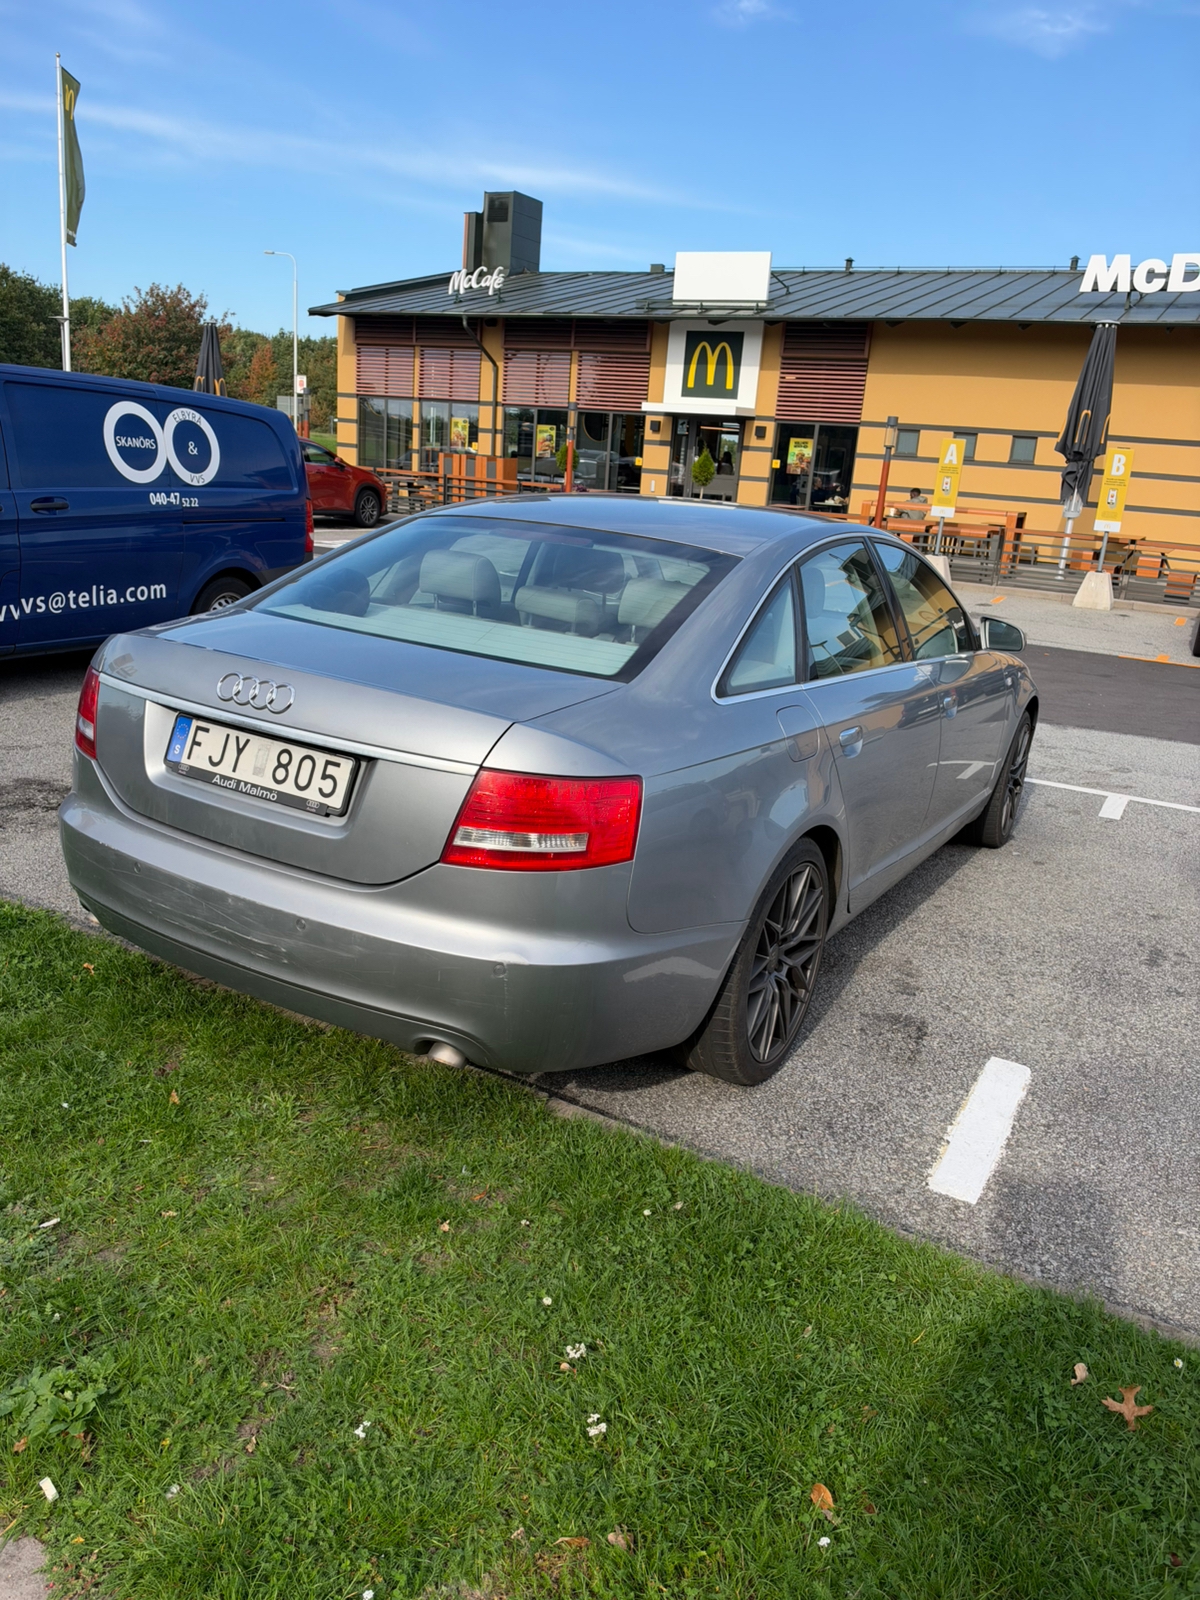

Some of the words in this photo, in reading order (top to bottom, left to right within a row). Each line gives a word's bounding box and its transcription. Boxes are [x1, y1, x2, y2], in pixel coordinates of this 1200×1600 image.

[448, 265, 505, 296] McCafé
[1079, 253, 1200, 293] McD
[115, 435, 156, 450] SKANÖRS
[187, 441, 198, 455] &
[943, 443, 957, 465] A
[1110, 453, 1126, 476] B
[190, 474, 205, 484] VVS
[149, 492, 180, 506] 040-47
[174, 744, 181, 755] S
[186, 725, 250, 773] FJY
[271, 748, 341, 799] 805
[212, 774, 237, 789] Audi
[239, 782, 277, 801] Malmö
